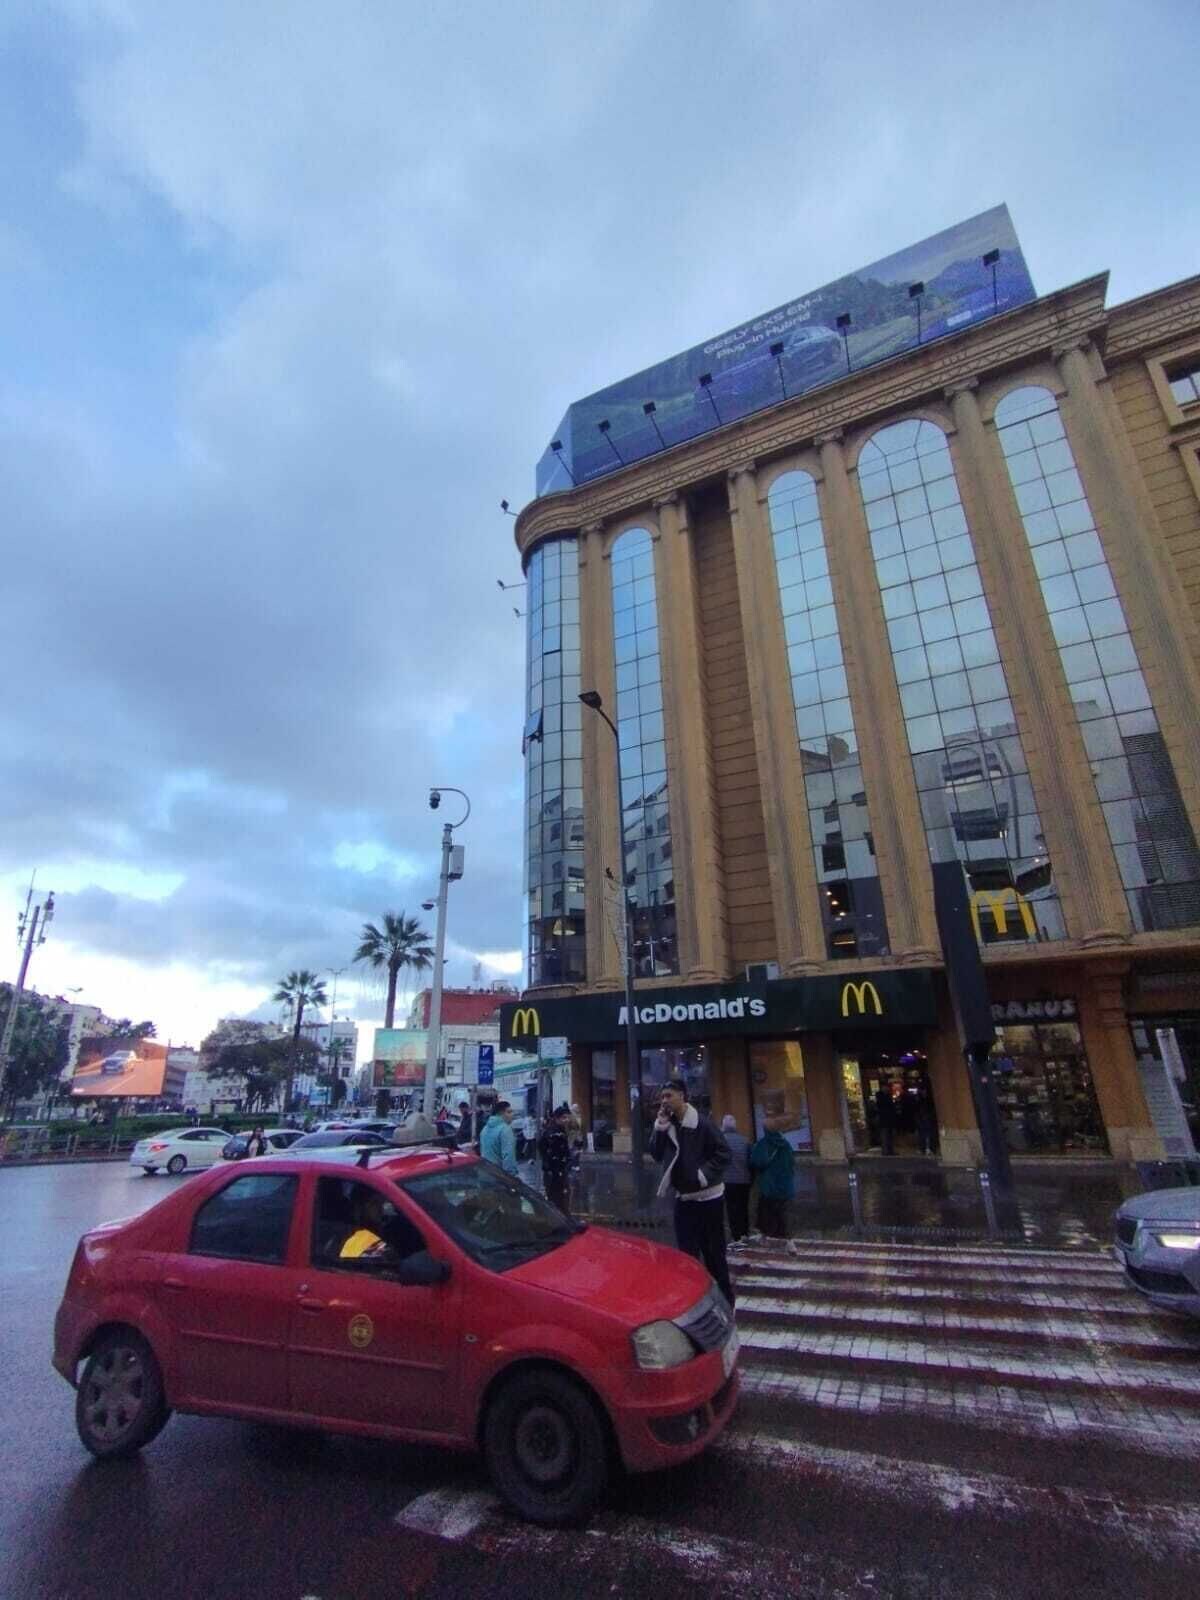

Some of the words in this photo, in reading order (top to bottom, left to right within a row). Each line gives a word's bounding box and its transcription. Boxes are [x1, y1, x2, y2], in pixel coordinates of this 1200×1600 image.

[765, 311, 811, 337] Hybrid
[703, 328, 749, 354] GEELY
[617, 997, 767, 1025] McDonald's
